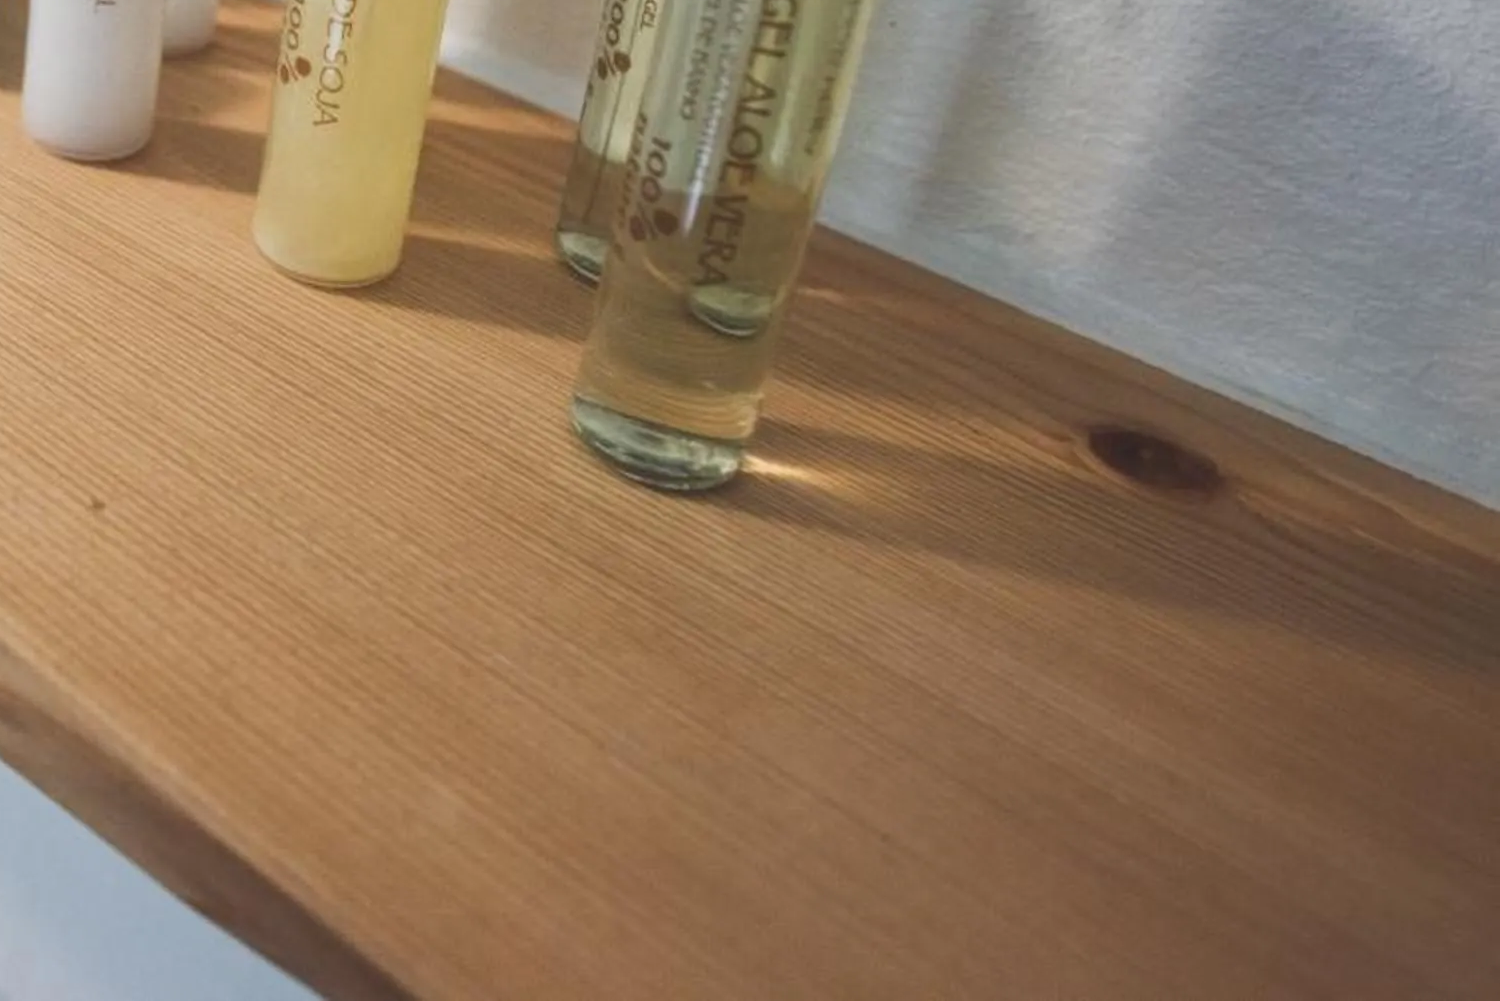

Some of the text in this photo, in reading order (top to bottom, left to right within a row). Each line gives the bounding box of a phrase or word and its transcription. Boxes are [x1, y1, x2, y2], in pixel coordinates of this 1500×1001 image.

[696, 16, 718, 47] DE
[312, 43, 349, 127] SOJA
[720, 73, 778, 186] ALOE
[691, 195, 748, 286] VERA
